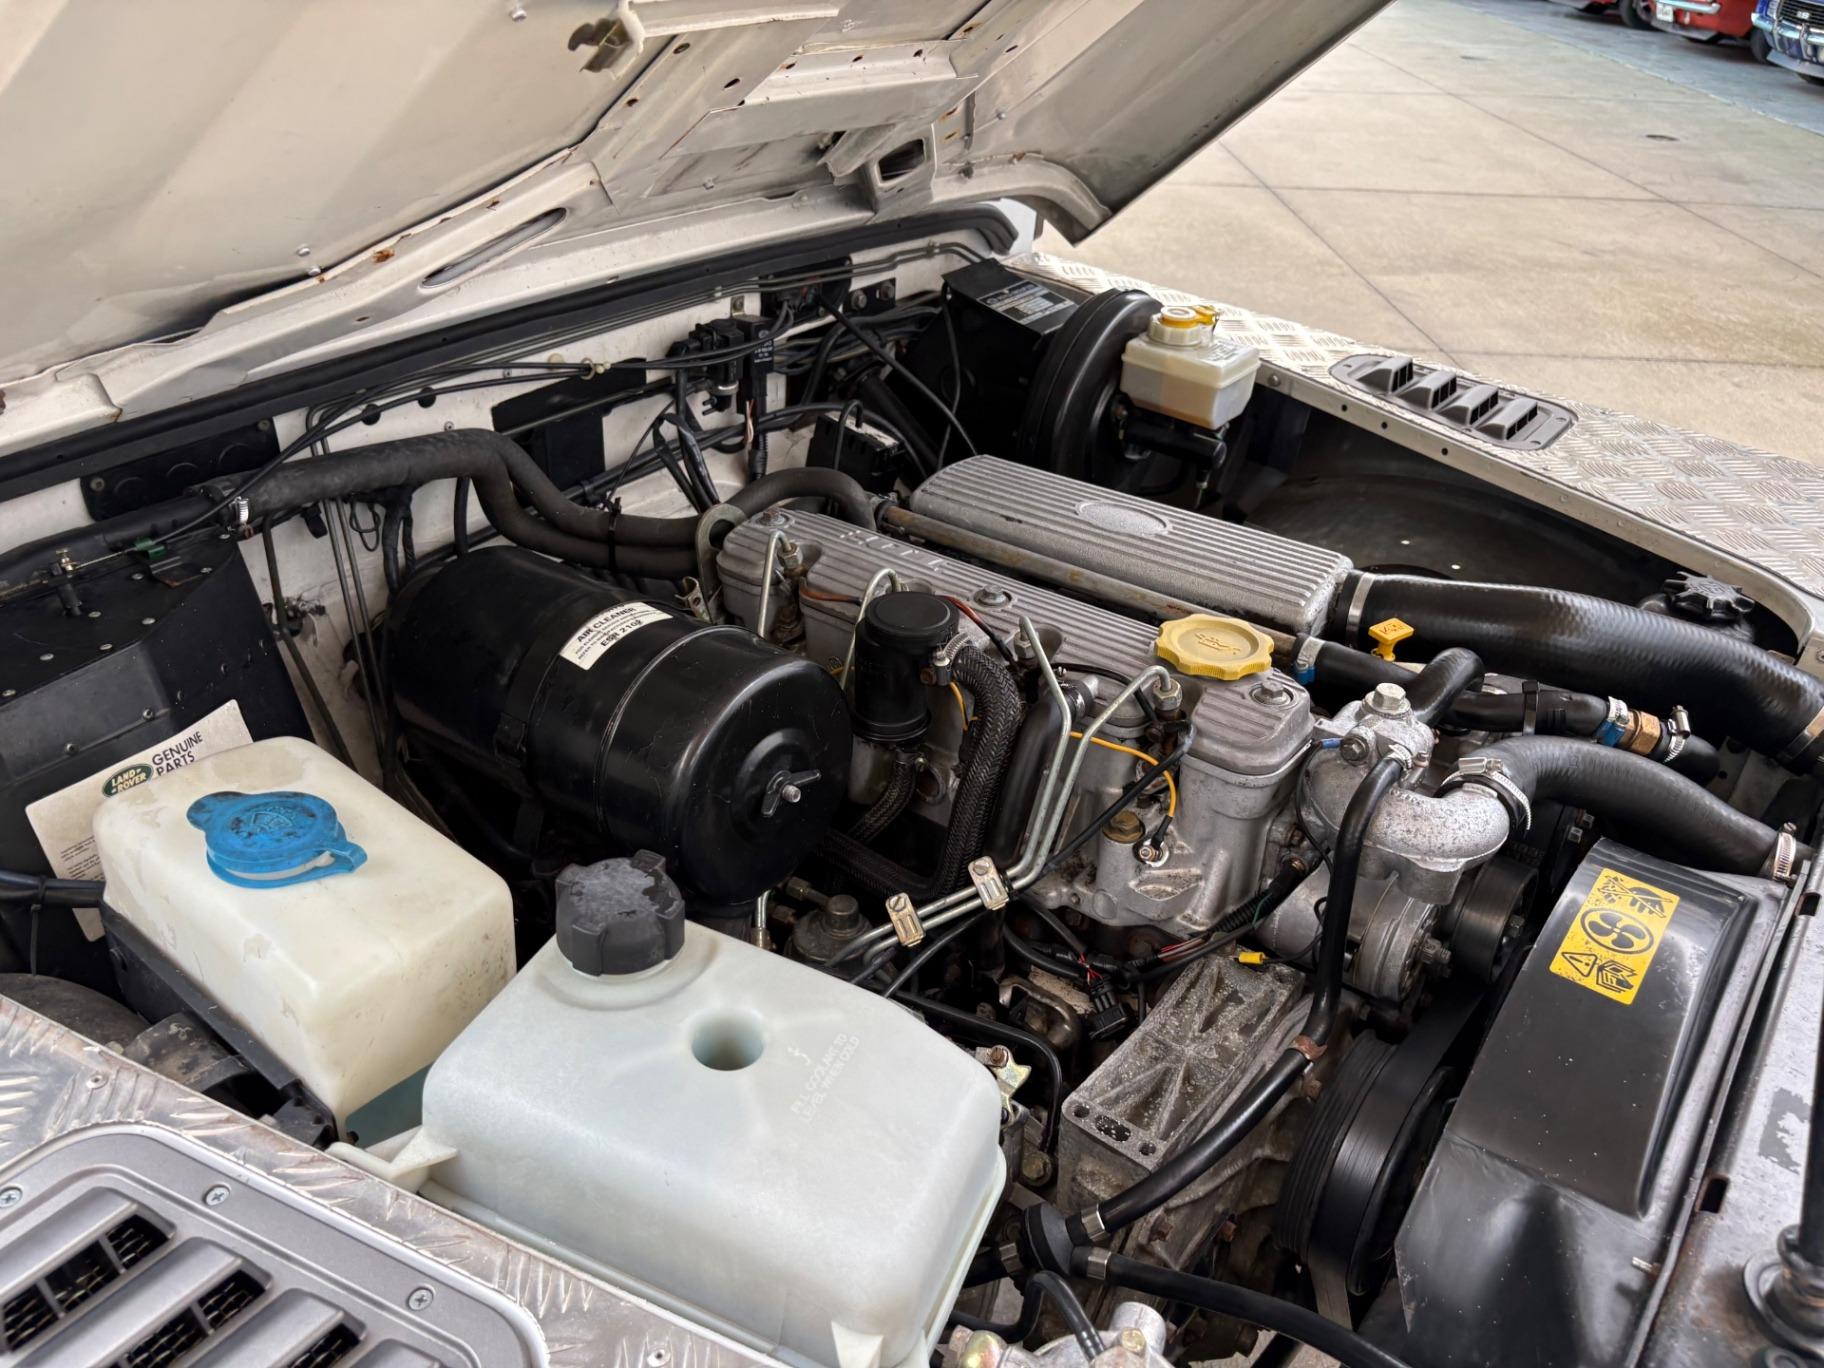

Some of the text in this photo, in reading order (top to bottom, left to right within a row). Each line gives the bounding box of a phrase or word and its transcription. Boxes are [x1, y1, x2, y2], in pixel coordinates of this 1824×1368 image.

[577, 628, 594, 642] AIR
[593, 607, 637, 629] CLEANER
[152, 731, 203, 766] GENUINE
[156, 751, 195, 776] PARTS
